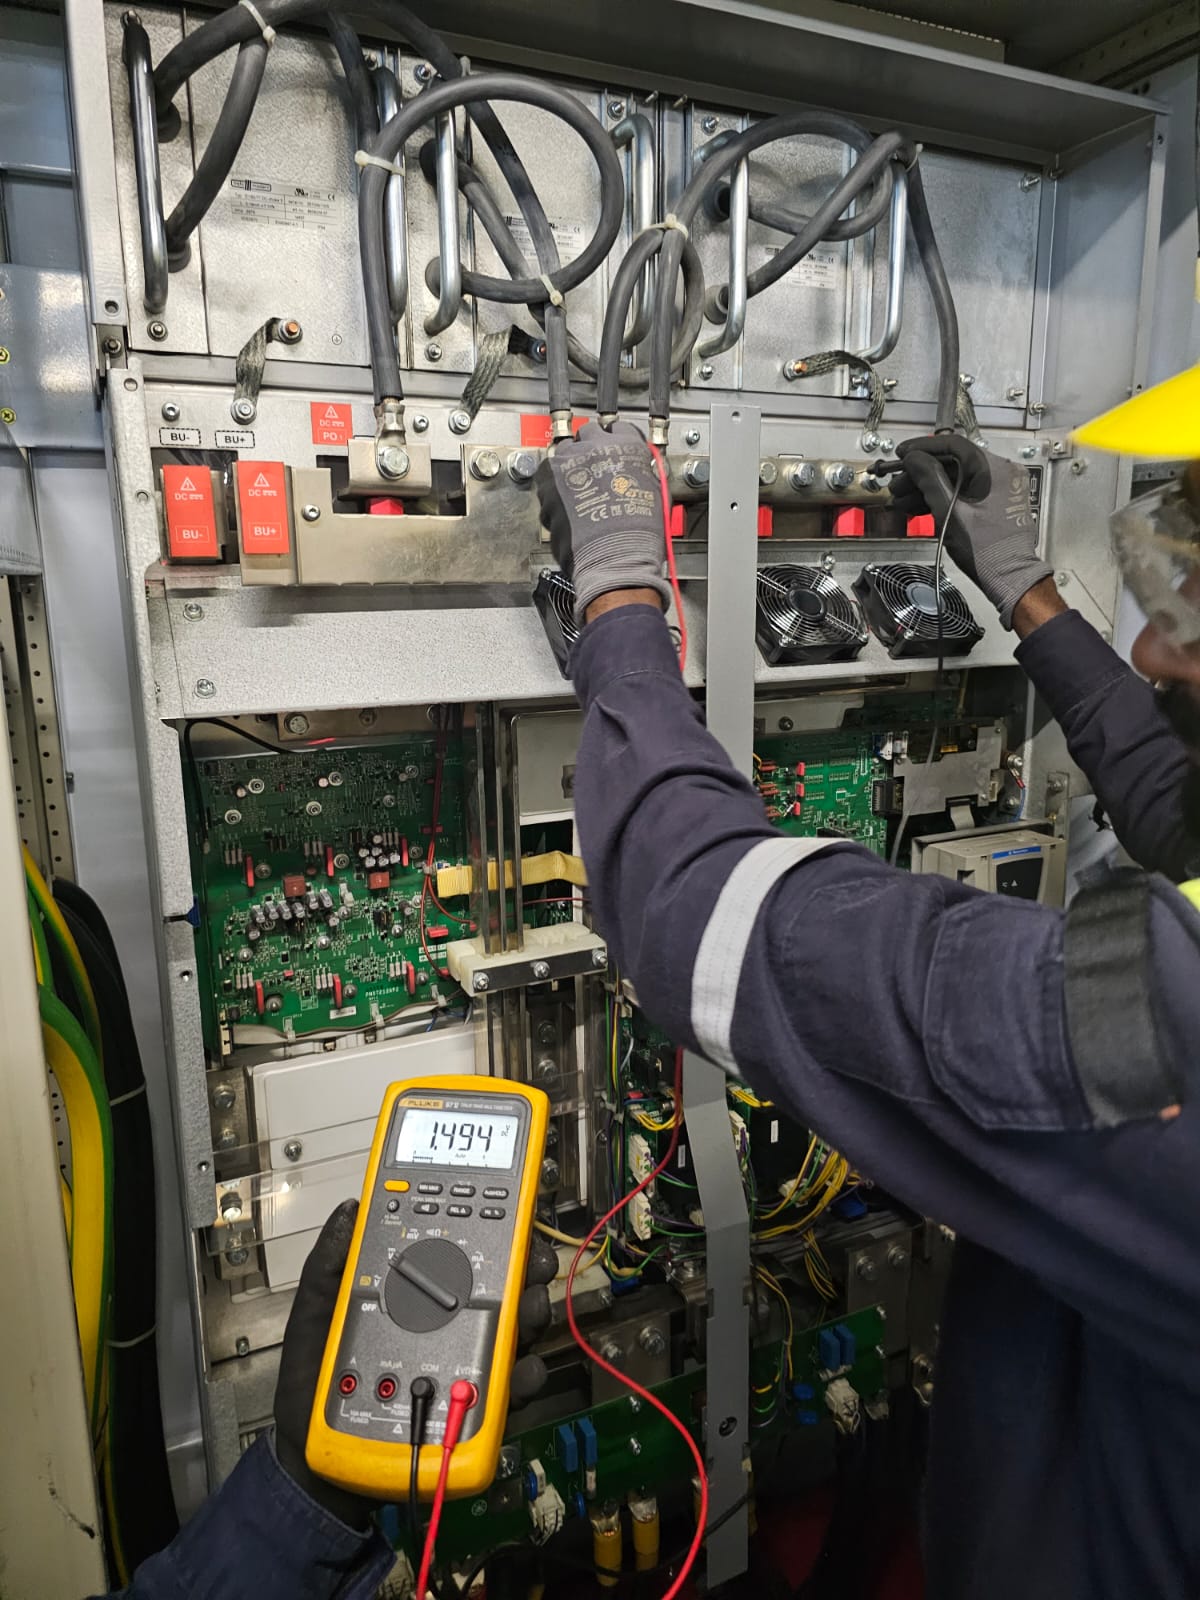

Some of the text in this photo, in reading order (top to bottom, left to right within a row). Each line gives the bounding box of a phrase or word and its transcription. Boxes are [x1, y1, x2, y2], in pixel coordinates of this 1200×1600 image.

[170, 432, 190, 441] BU-
[224, 435, 246, 444] BU+
[174, 493, 188, 501] DC
[248, 489, 261, 497] DC
[182, 529, 203, 540] BU-
[254, 526, 277, 536] BU+
[430, 1121, 493, 1152] 1.494
[361, 1303, 377, 1312] OFF
[420, 1363, 440, 1372] COM
